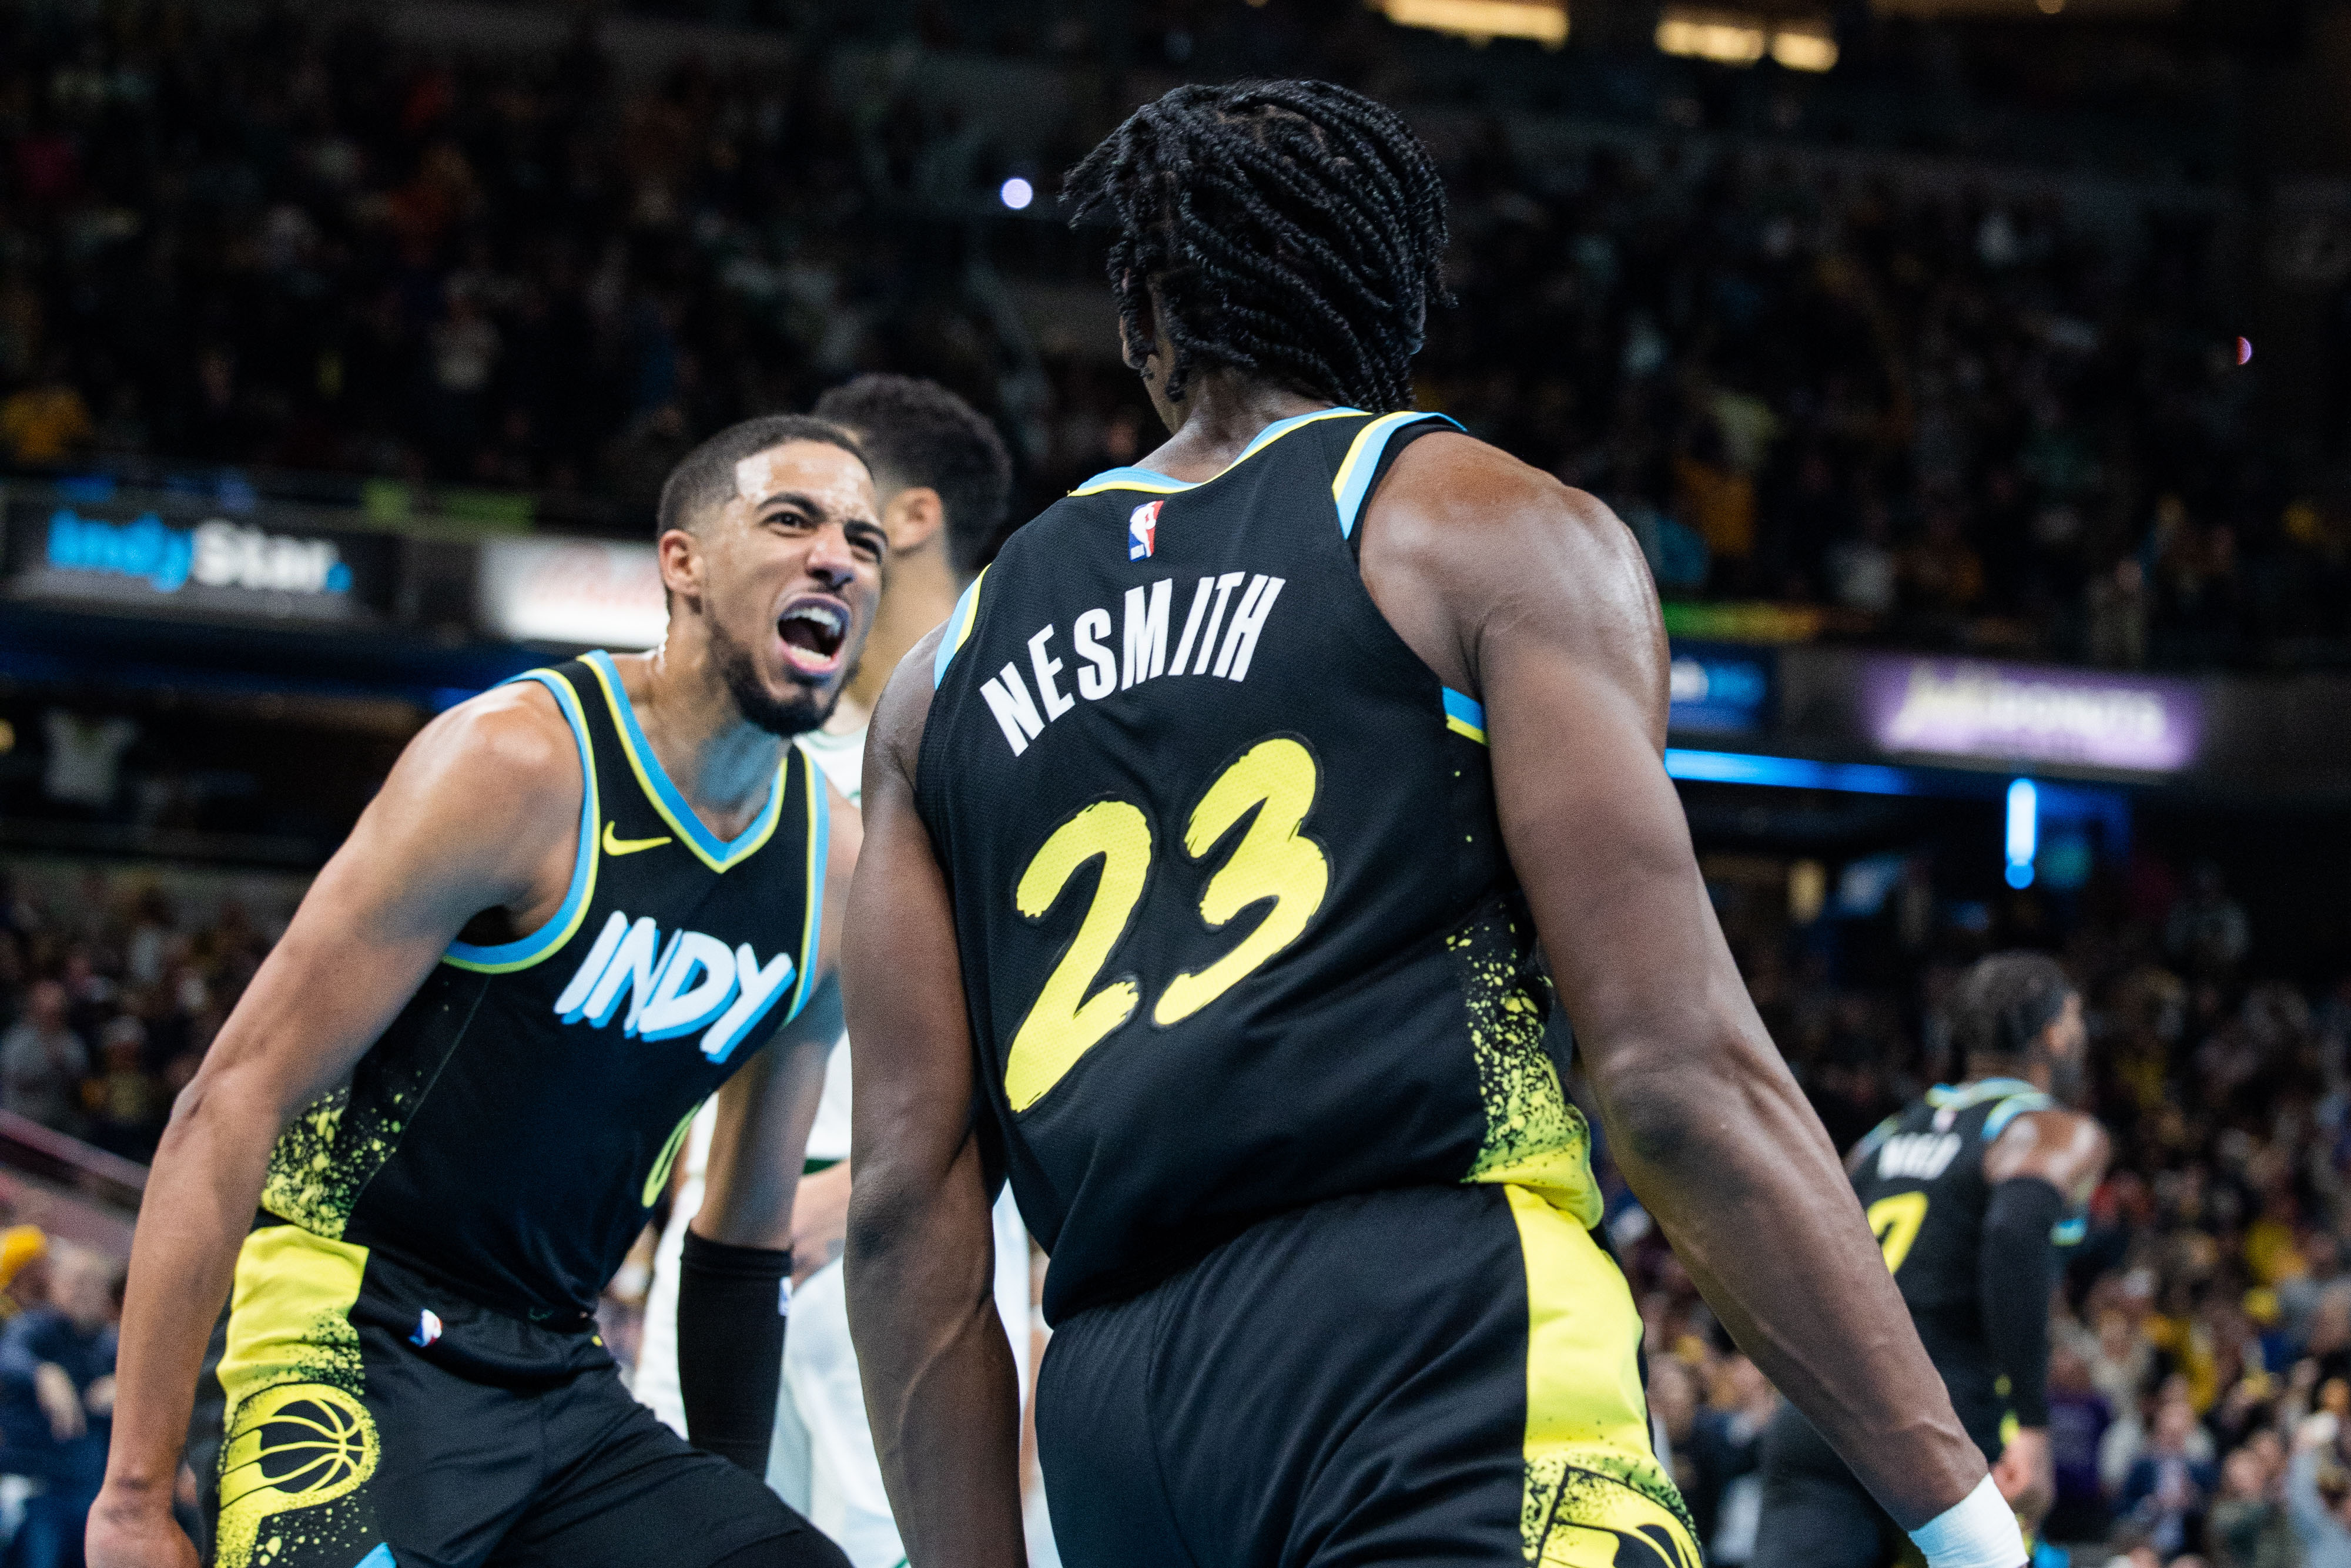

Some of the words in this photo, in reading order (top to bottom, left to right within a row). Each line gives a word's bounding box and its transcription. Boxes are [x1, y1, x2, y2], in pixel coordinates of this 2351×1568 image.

[980, 571, 1285, 757] NESMITH
[554, 910, 797, 1064] INDY
[1004, 738, 1328, 1113] 23
